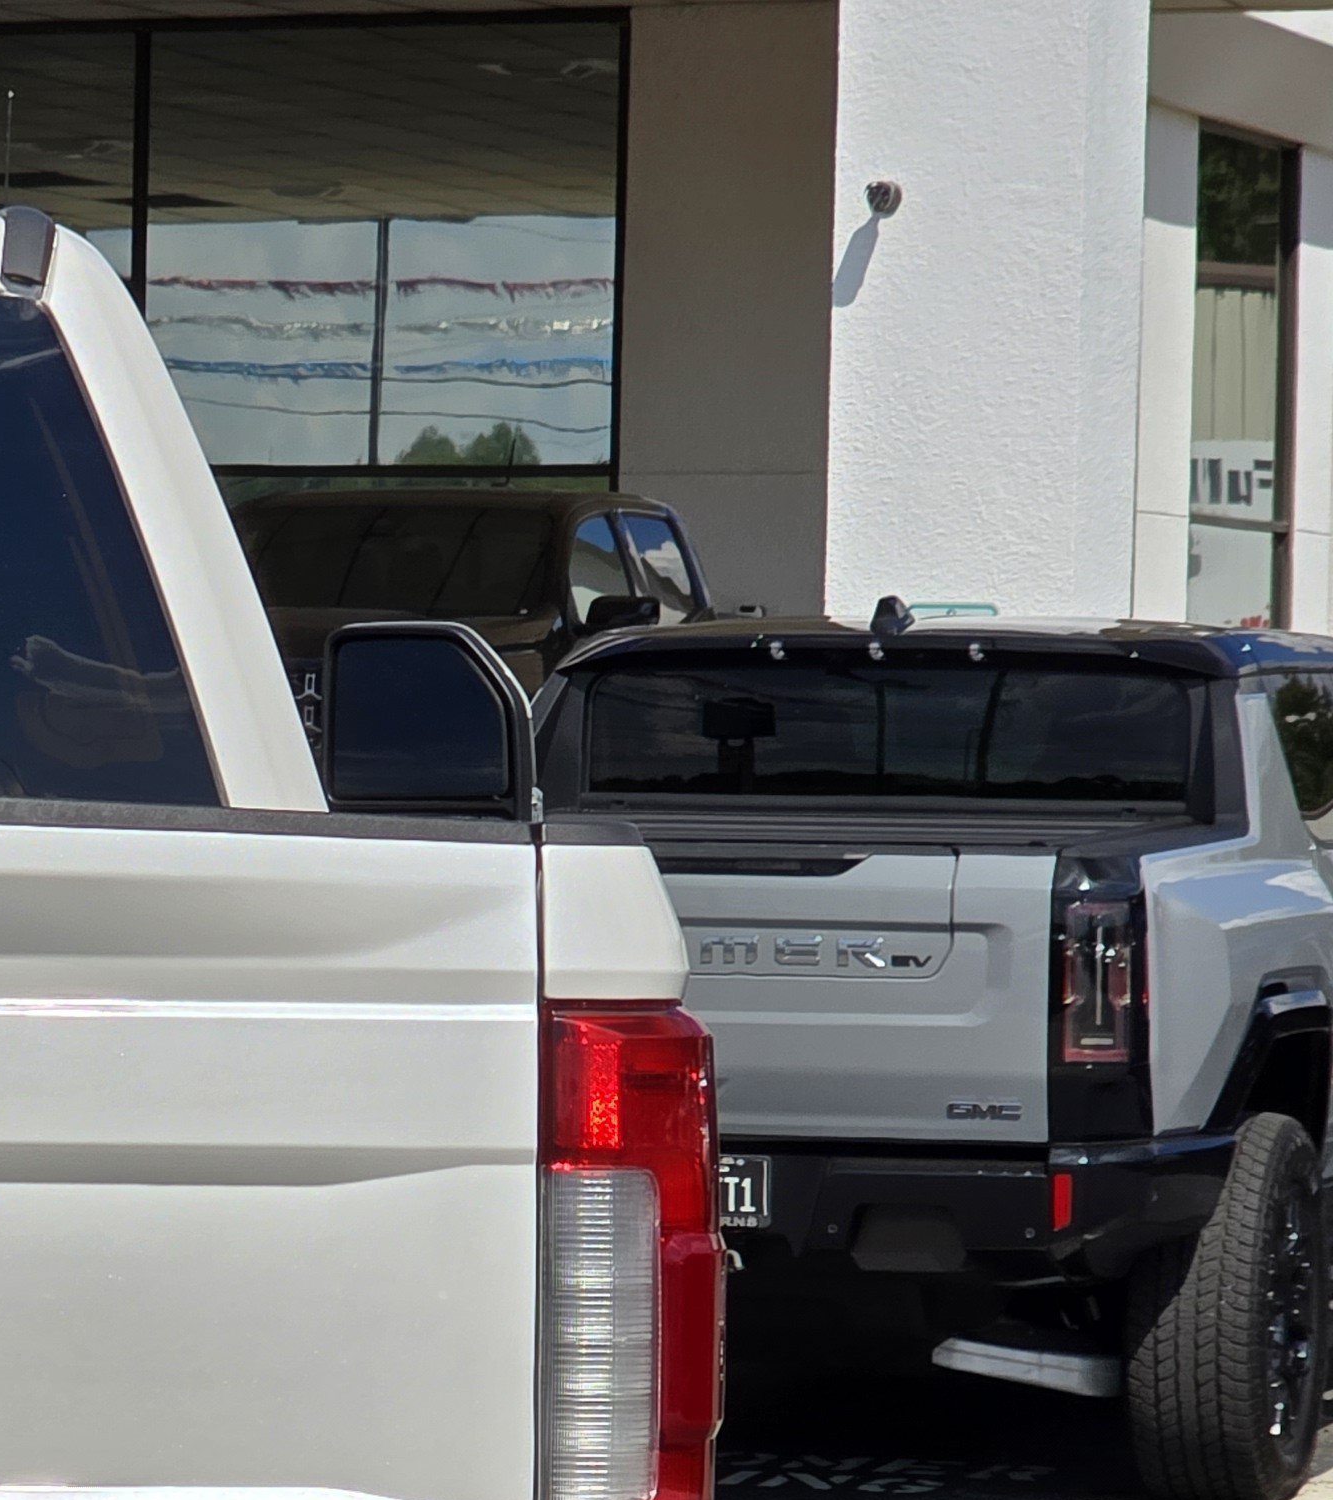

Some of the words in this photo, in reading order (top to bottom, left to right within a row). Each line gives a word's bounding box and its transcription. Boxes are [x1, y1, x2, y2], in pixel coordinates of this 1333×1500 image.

[891, 954, 933, 969] EV
[946, 1100, 1023, 1122] GMC
[719, 1176, 757, 1213] T1
